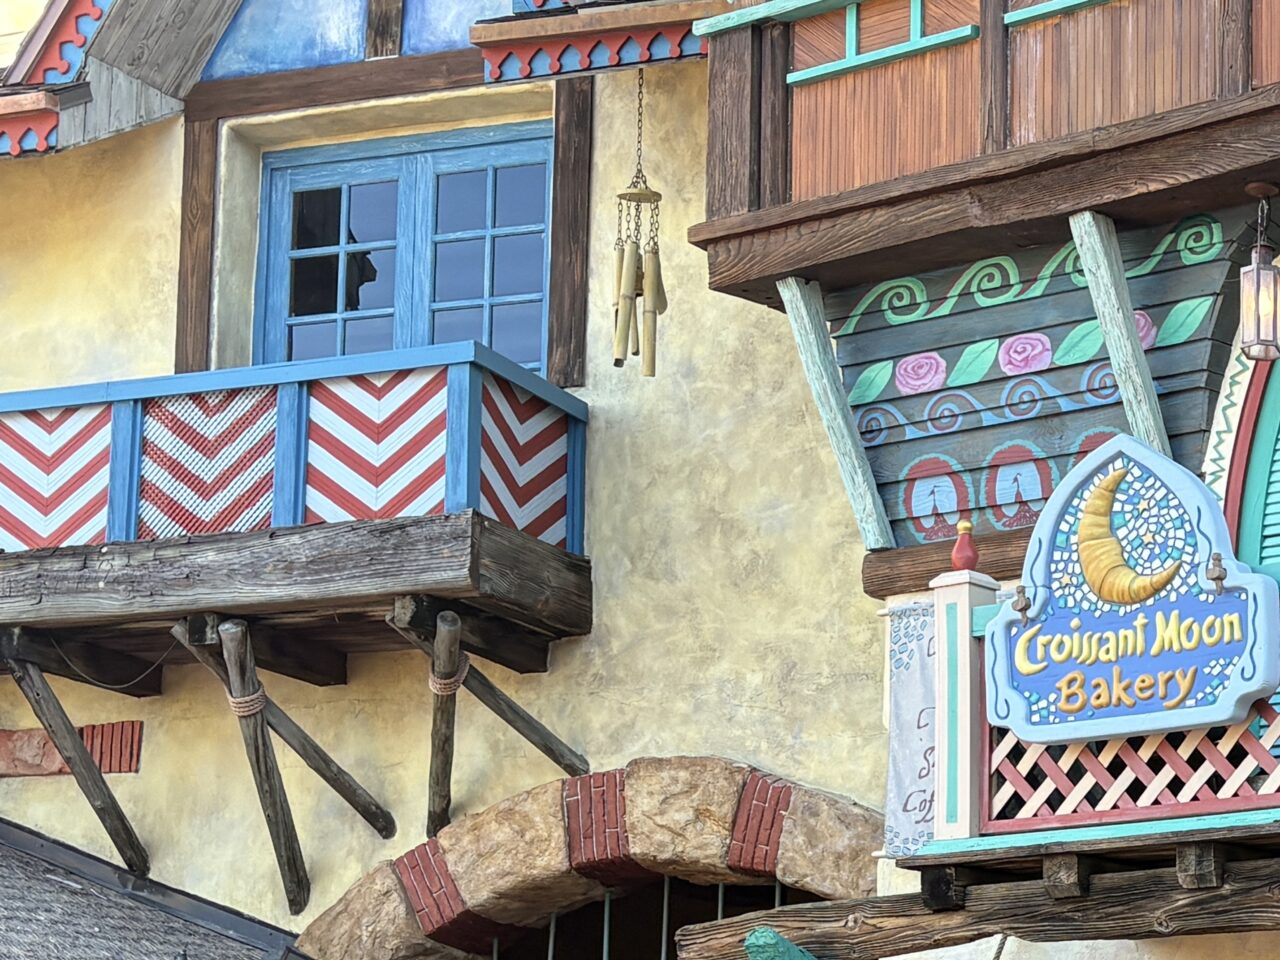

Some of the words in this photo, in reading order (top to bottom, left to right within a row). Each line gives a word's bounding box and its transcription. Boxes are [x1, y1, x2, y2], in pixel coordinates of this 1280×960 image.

[1015, 613, 1149, 676] Croissant
[1151, 609, 1244, 657] Moon
[1056, 666, 1199, 713] Bakery
